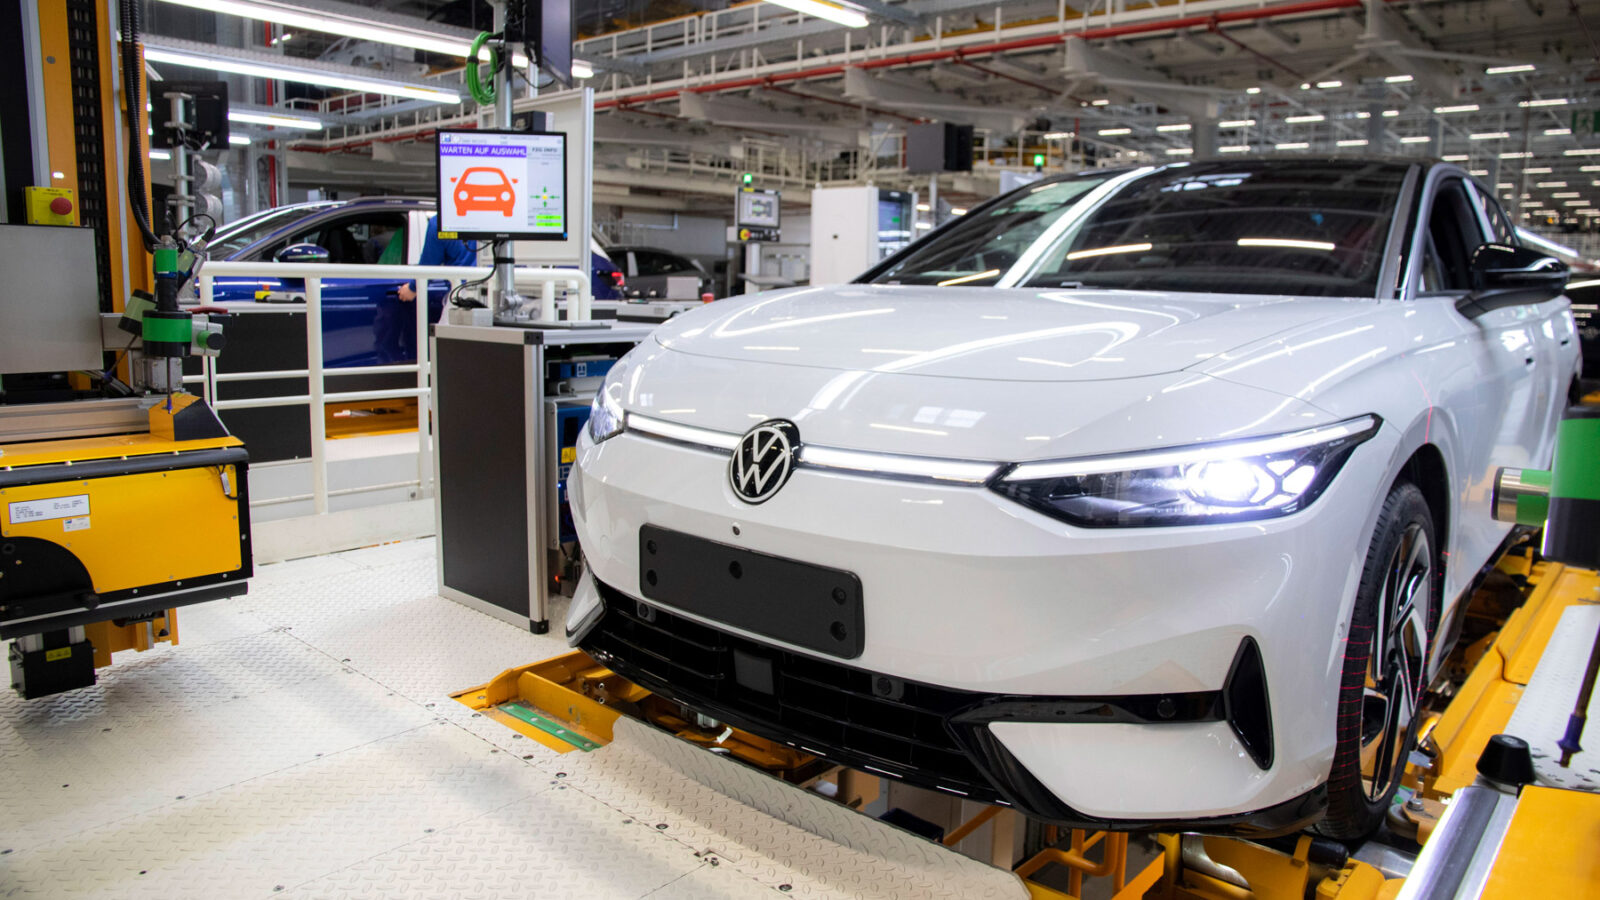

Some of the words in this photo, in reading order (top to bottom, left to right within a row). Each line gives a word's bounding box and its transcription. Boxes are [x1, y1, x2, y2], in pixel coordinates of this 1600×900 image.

[441, 146, 472, 154] WARTEN
[474, 146, 489, 154] AUF
[491, 147, 526, 156] AUSWAHL
